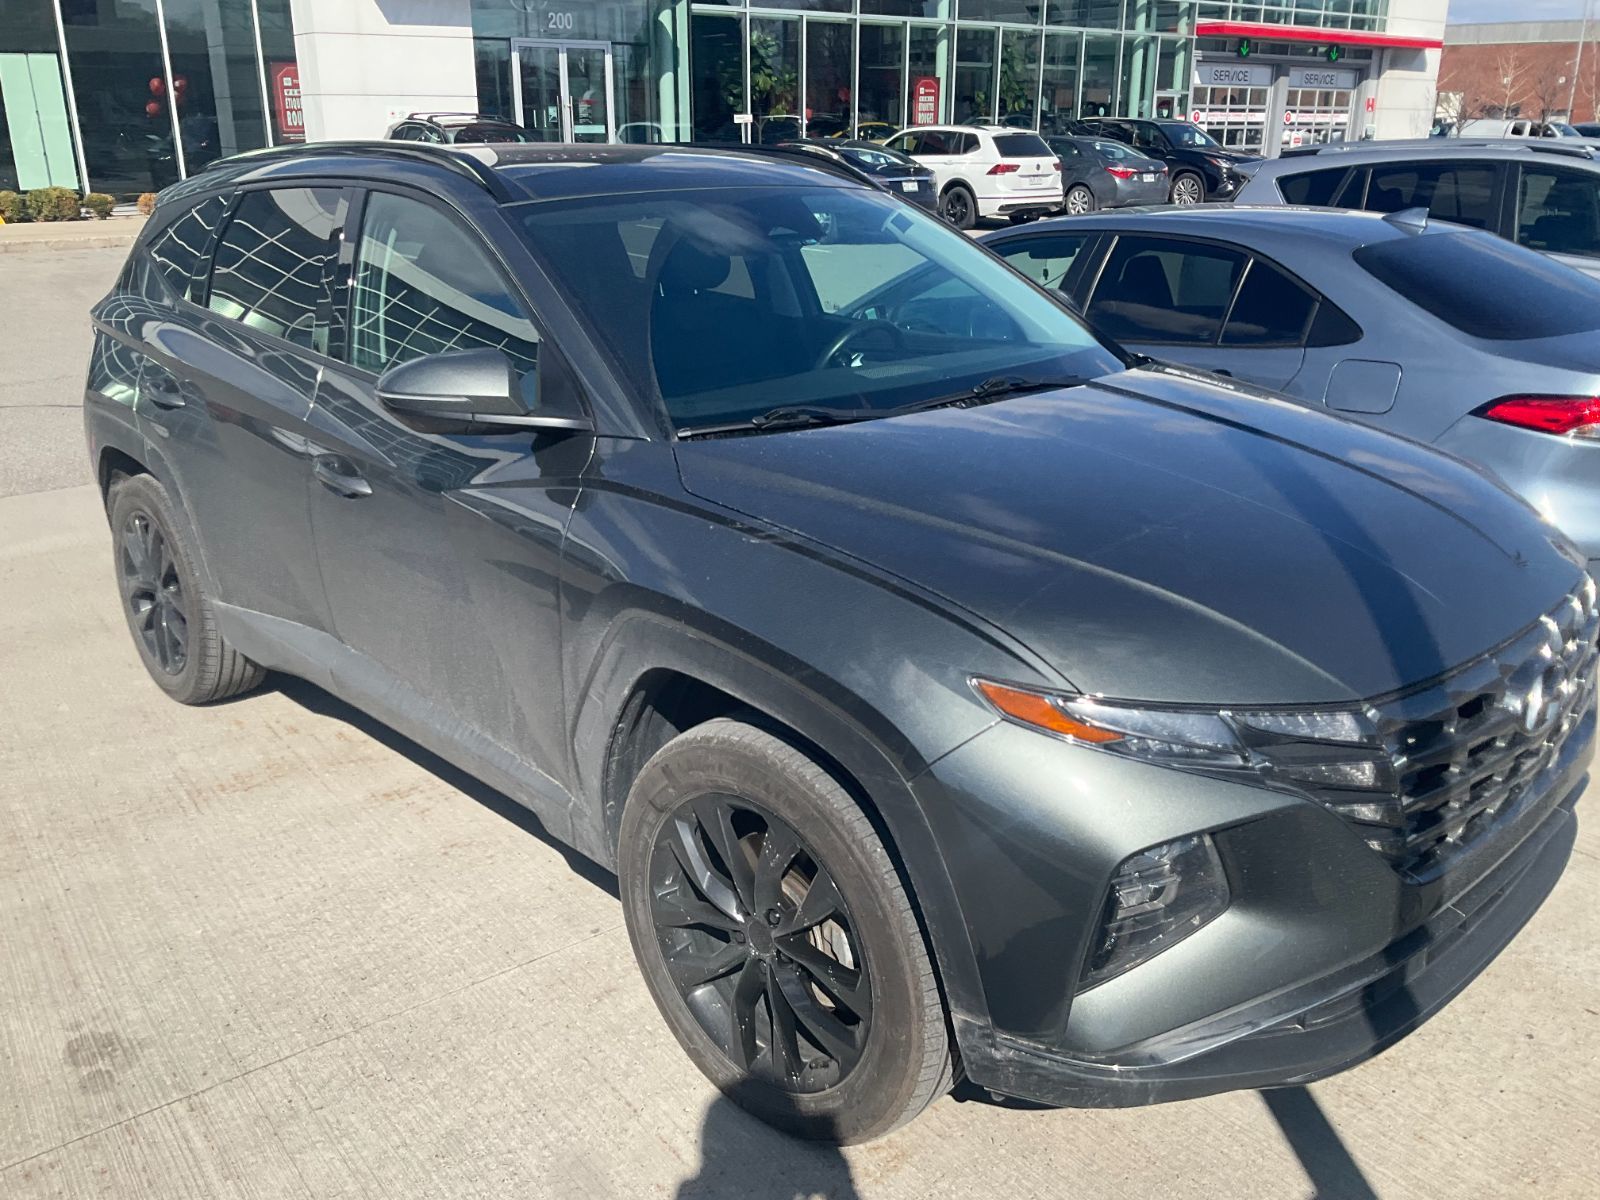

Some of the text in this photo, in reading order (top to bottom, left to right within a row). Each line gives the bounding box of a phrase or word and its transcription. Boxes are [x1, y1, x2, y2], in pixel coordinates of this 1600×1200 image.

[548, 12, 573, 29] 200
[1213, 69, 1249, 82] SERVICE
[1304, 73, 1336, 85] SERVICE
